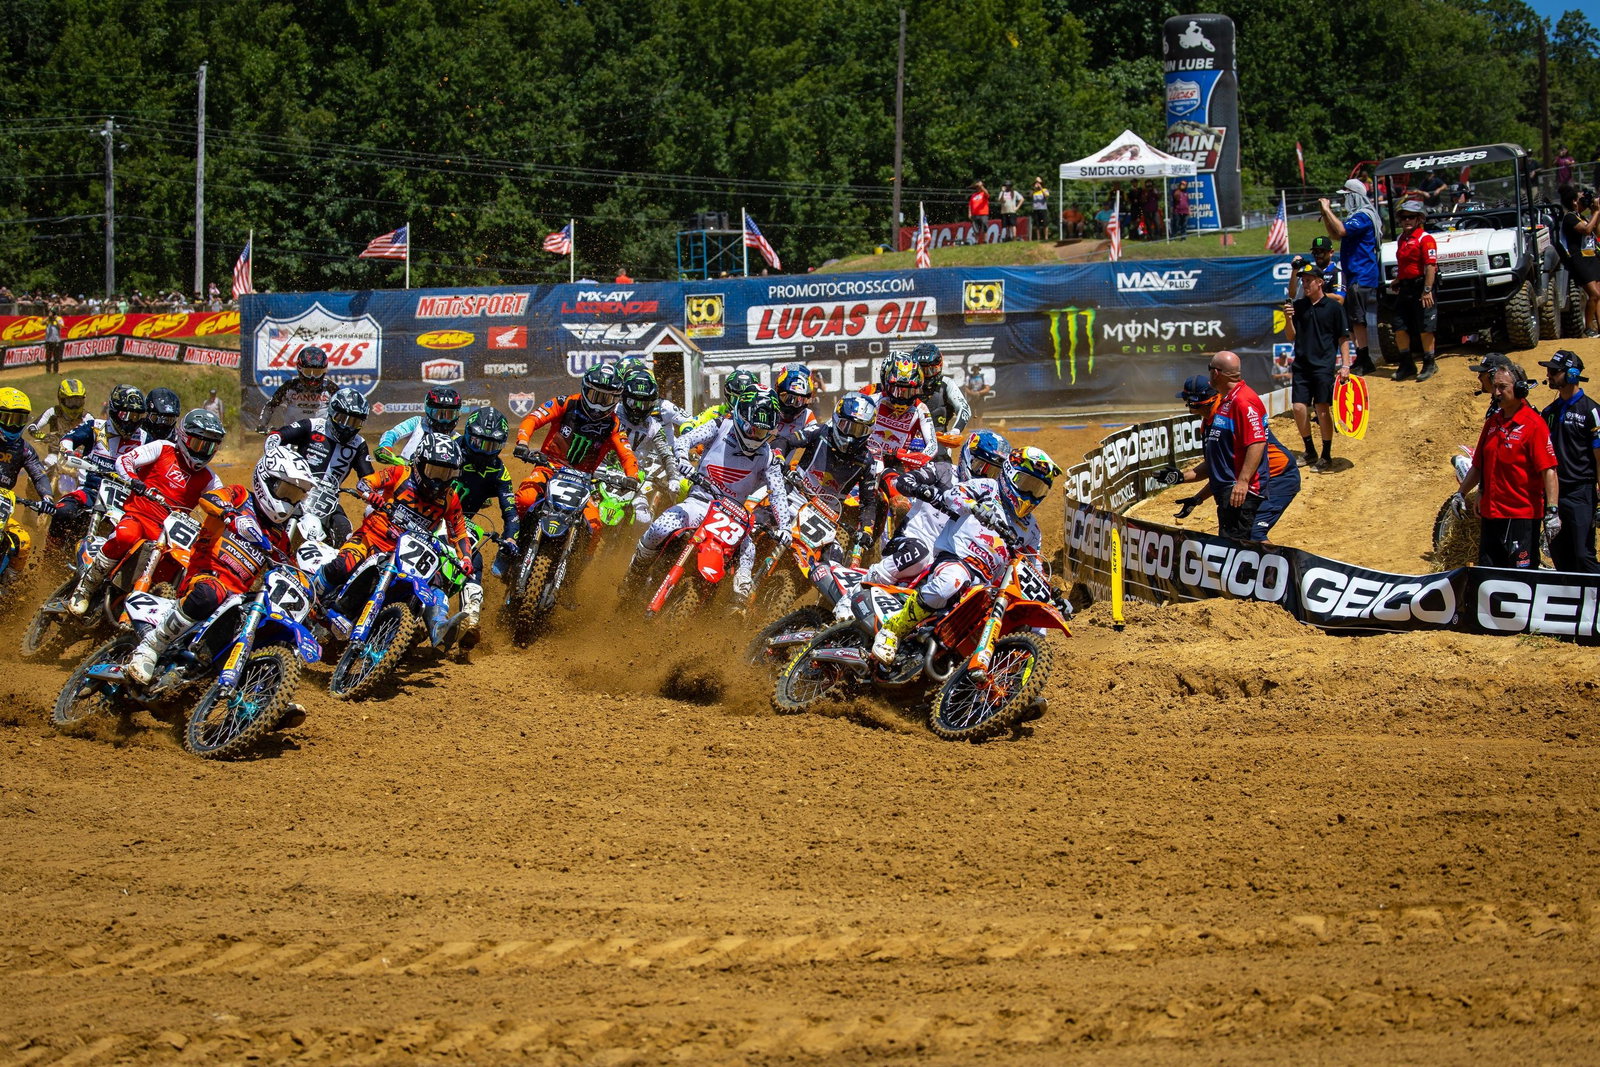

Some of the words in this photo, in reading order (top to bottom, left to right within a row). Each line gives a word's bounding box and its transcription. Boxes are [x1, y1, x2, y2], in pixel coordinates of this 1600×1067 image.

[1178, 58, 1214, 70] LUBE
[1080, 165, 1145, 176] SMDR.ORG
[1403, 150, 1487, 169] alpinestars
[1448, 251, 1466, 259] MEDIC
[769, 279, 914, 298] PROMOTOCROSS.COM
[1169, 279, 1191, 289] PLUS
[577, 291, 635, 301] MX-ATV
[969, 284, 999, 308] 50
[561, 301, 659, 315] LEGENDS
[691, 298, 720, 322] 50
[3, 316, 46, 340] FM
[67, 314, 126, 339] FMF
[132, 313, 189, 337] FMF
[195, 311, 240, 337] FM
[561, 323, 657, 339] FLY
[755, 302, 870, 340] LUCAS
[875, 301, 929, 334] OIL
[1103, 319, 1225, 342] MONSTER
[4, 346, 47, 366] MOTOSPO
[1122, 344, 1206, 353] ENERGY
[428, 364, 459, 379] 100%
[484, 363, 528, 374] STACYC
[262, 376, 283, 387] OIL
[385, 403, 426, 412] SUZUK
[1173, 420, 1203, 454] EICO
[169, 469, 188, 483] FLY
[397, 490, 444, 521] FXR
[552, 481, 588, 507] 3
[704, 512, 745, 546] 23
[800, 515, 833, 543] 5
[297, 544, 323, 561] 26
[400, 540, 437, 577] 26
[895, 548, 920, 567] FOX
[1121, 525, 1174, 579] GEICO
[1180, 539, 1289, 602] GEICO
[1018, 566, 1051, 602] 222
[1301, 567, 1456, 625] GEICO
[1477, 579, 1600, 638] GEI
[784, 641, 812, 677] PIRELLI
